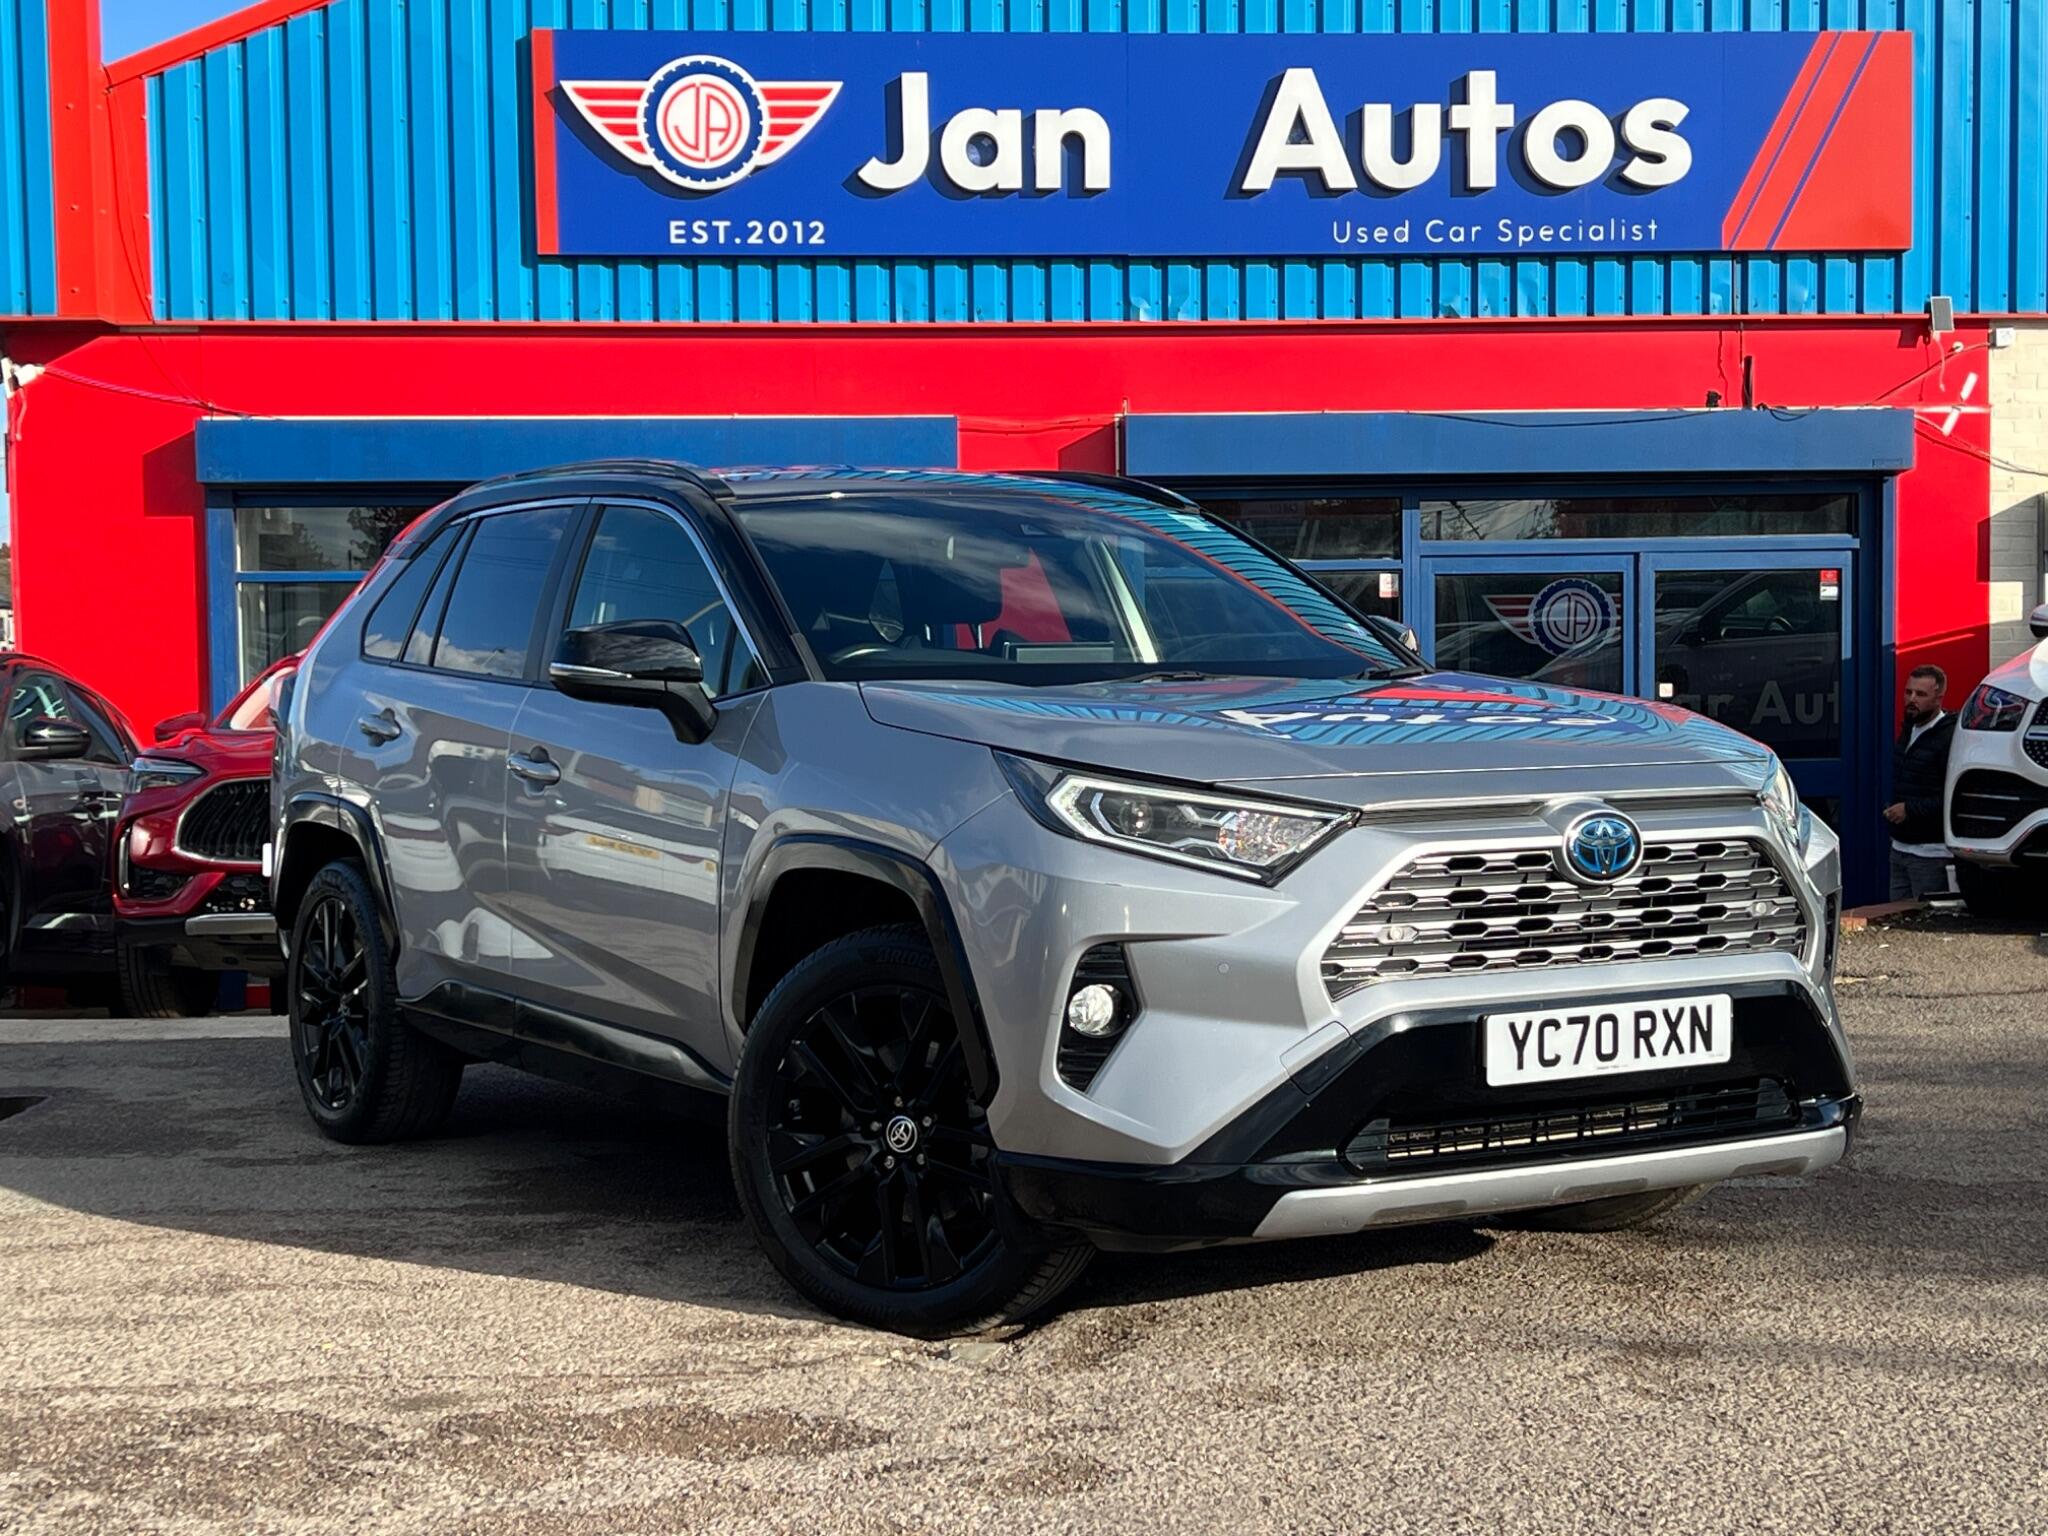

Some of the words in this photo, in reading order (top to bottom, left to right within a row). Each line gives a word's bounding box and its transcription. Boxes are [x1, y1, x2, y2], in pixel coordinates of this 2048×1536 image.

[858, 72, 1110, 191] Jan
[1242, 68, 1693, 190] Autos
[669, 220, 826, 244] EST.2012
[1333, 219, 1409, 244] Used
[1425, 219, 1482, 243] Car
[1498, 218, 1658, 247] Specialist
[1508, 1012, 1619, 1071] YC70
[1633, 1004, 1713, 1059] RXN
